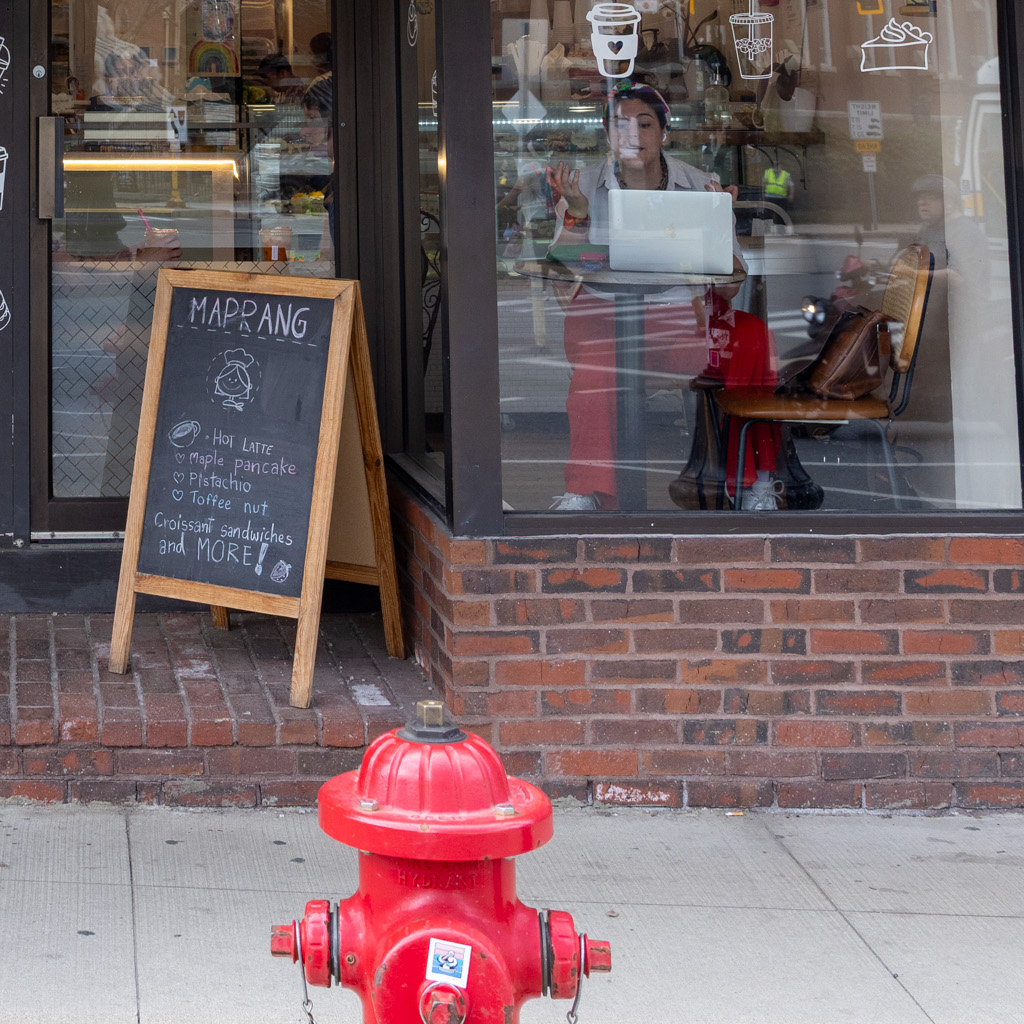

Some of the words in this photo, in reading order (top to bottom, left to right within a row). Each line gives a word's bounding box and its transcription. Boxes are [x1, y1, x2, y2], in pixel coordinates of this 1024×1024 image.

[190, 296, 310, 339] MAPRANG
[212, 427, 236, 448] HOT
[242, 437, 274, 456] LATTE
[234, 456, 297, 476] pancake
[189, 471, 252, 493] Pistachio
[189, 490, 231, 510] Toffee
[243, 500, 269, 516] nut
[154, 511, 215, 534] Croissant
[220, 519, 293, 546] sandwiches
[159, 531, 186, 556] and
[197, 536, 269, 576] MORE!
